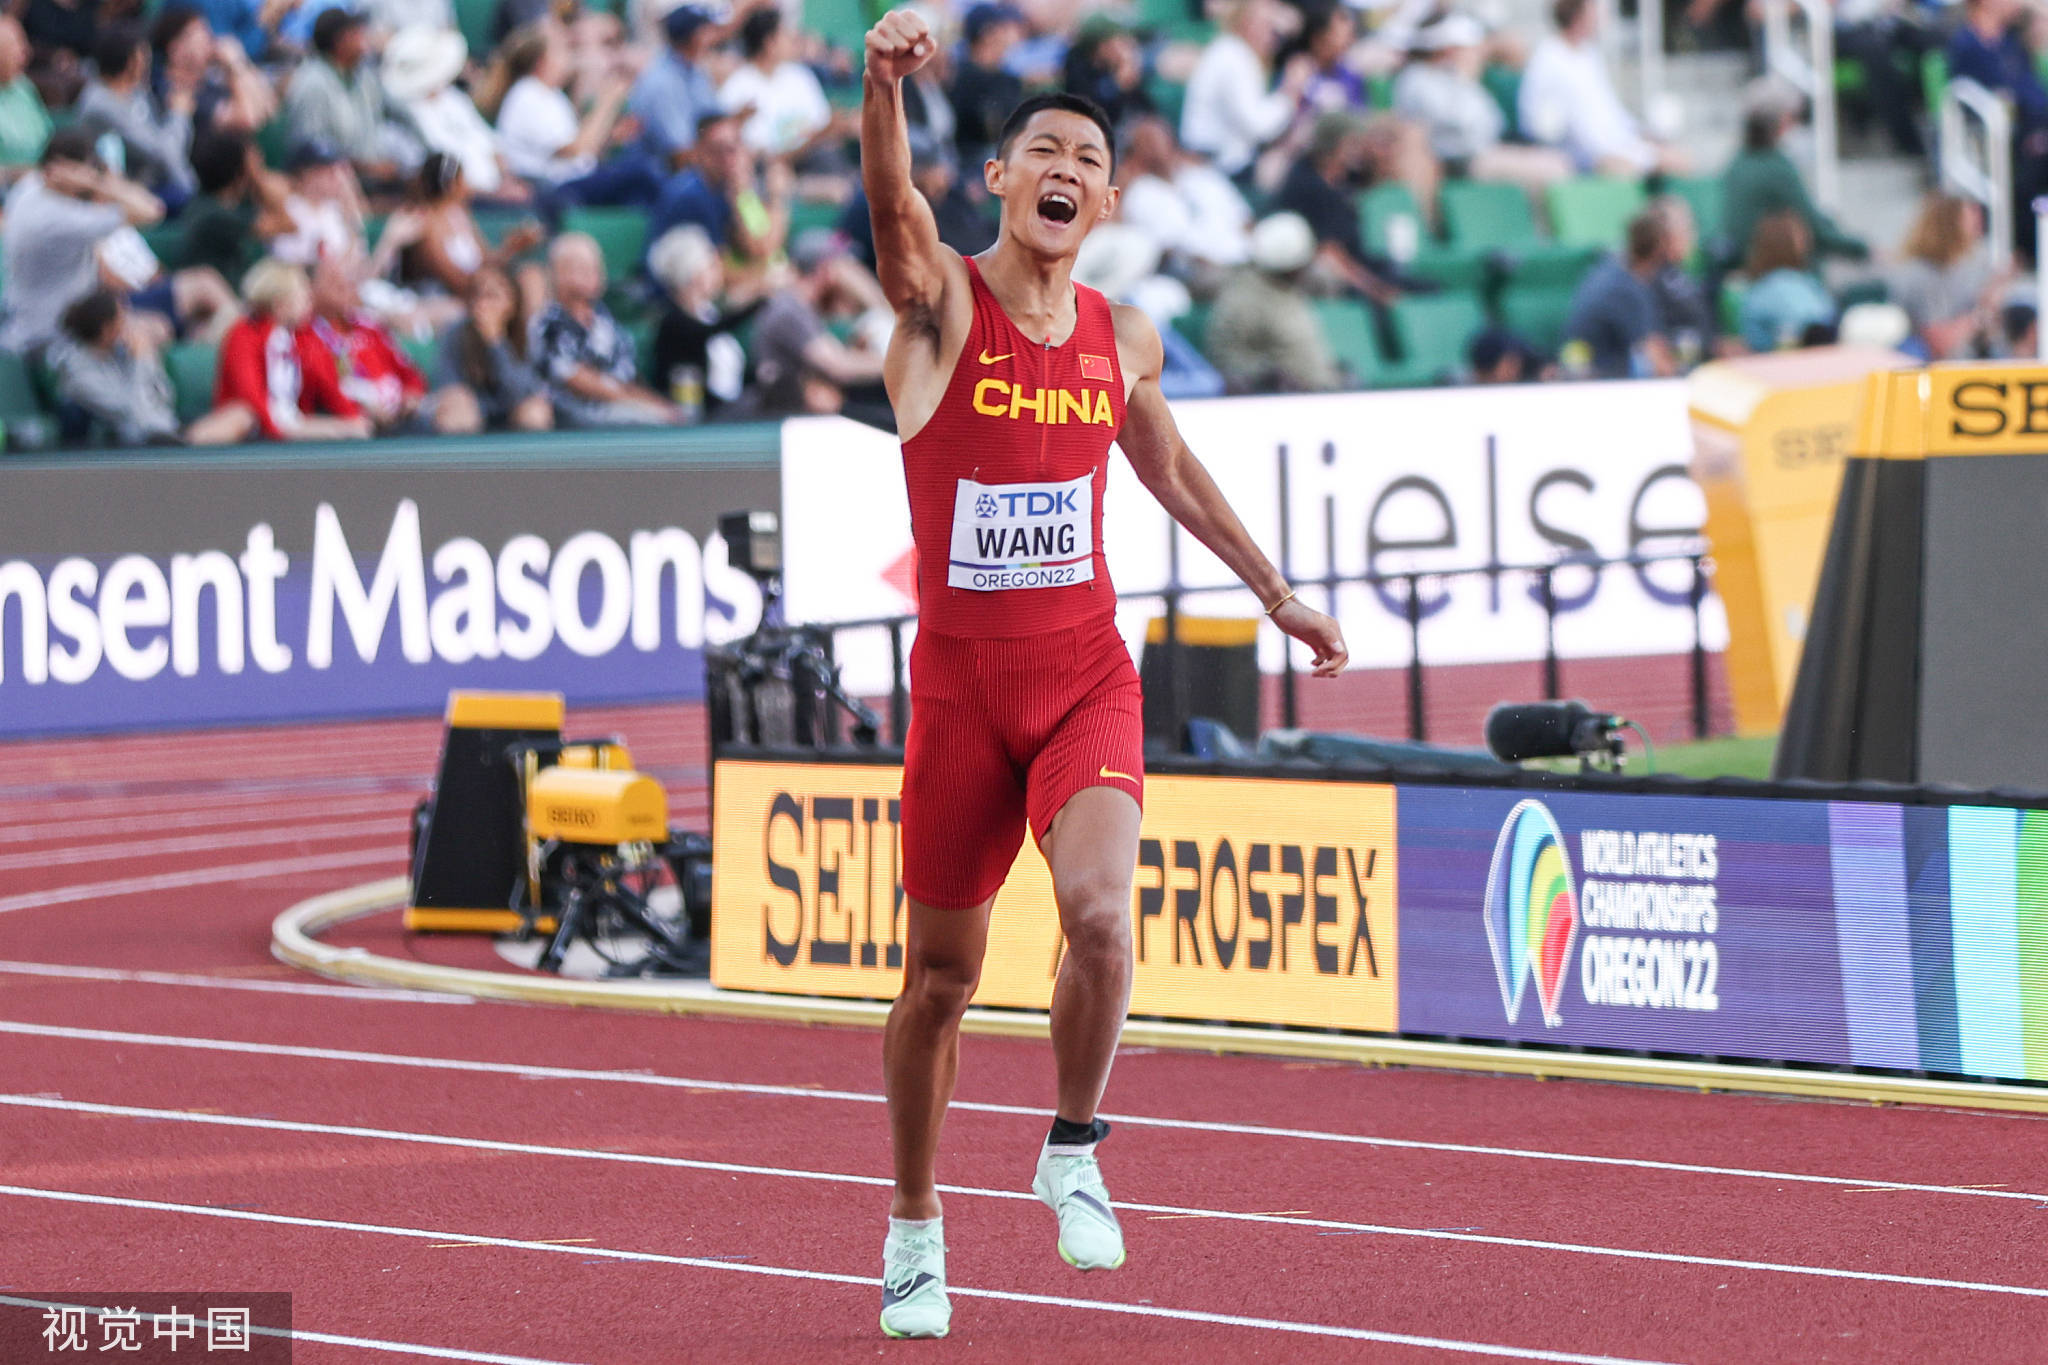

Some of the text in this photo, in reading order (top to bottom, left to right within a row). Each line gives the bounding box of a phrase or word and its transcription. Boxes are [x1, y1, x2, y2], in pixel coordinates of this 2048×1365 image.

[972, 378, 1114, 427] CHINA
[998, 487, 1078, 517] TDK
[975, 523, 1075, 559] WANG
[0, 497, 763, 685] nsent Masons
[973, 567, 1076, 588] OREGON22
[1138, 837, 1379, 978] PROSPEX
[1581, 934, 1719, 1011] OREGON22
